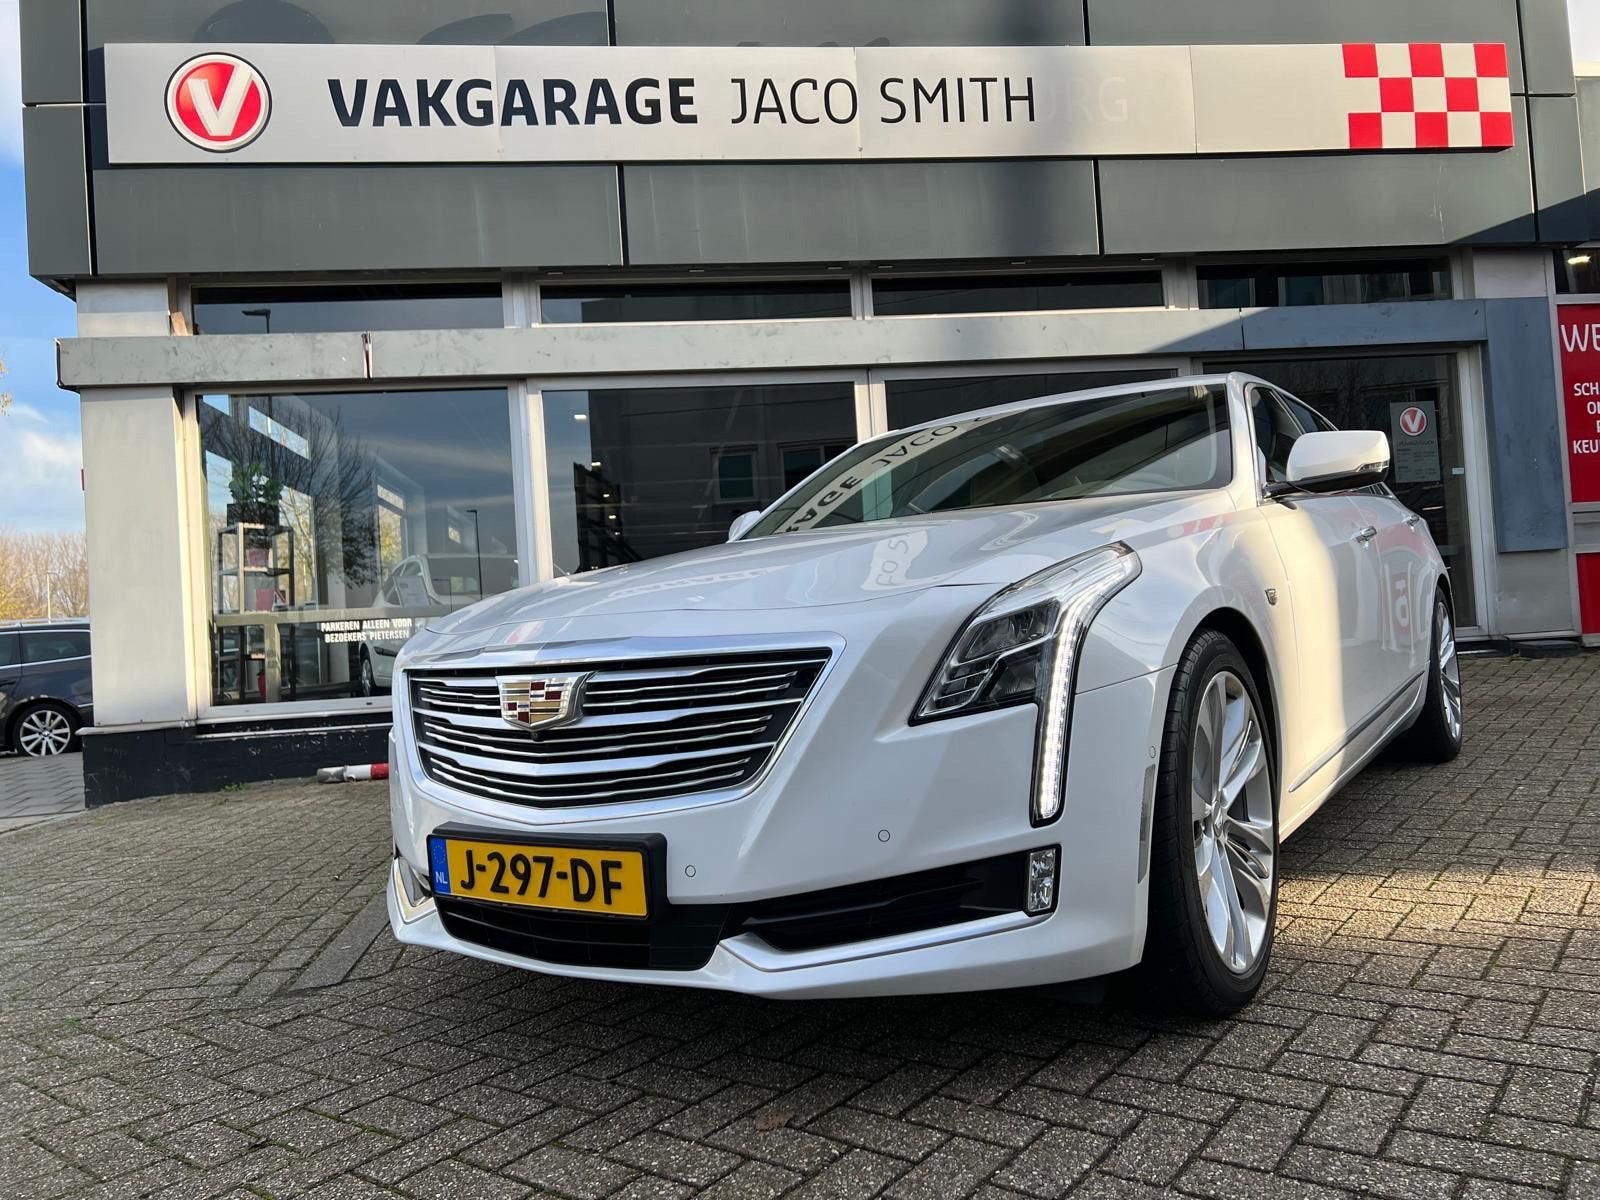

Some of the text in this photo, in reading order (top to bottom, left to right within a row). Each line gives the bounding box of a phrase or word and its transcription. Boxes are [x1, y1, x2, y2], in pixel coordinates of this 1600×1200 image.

[327, 76, 1036, 128] VAKGARAGE JACO SMITH
[321, 617, 412, 633] PARKEREN ALLEEN VOOR
[324, 629, 409, 643] BEZOEKERS PIETERSEN
[435, 870, 448, 885] NL
[460, 848, 622, 905] J-297-DF
